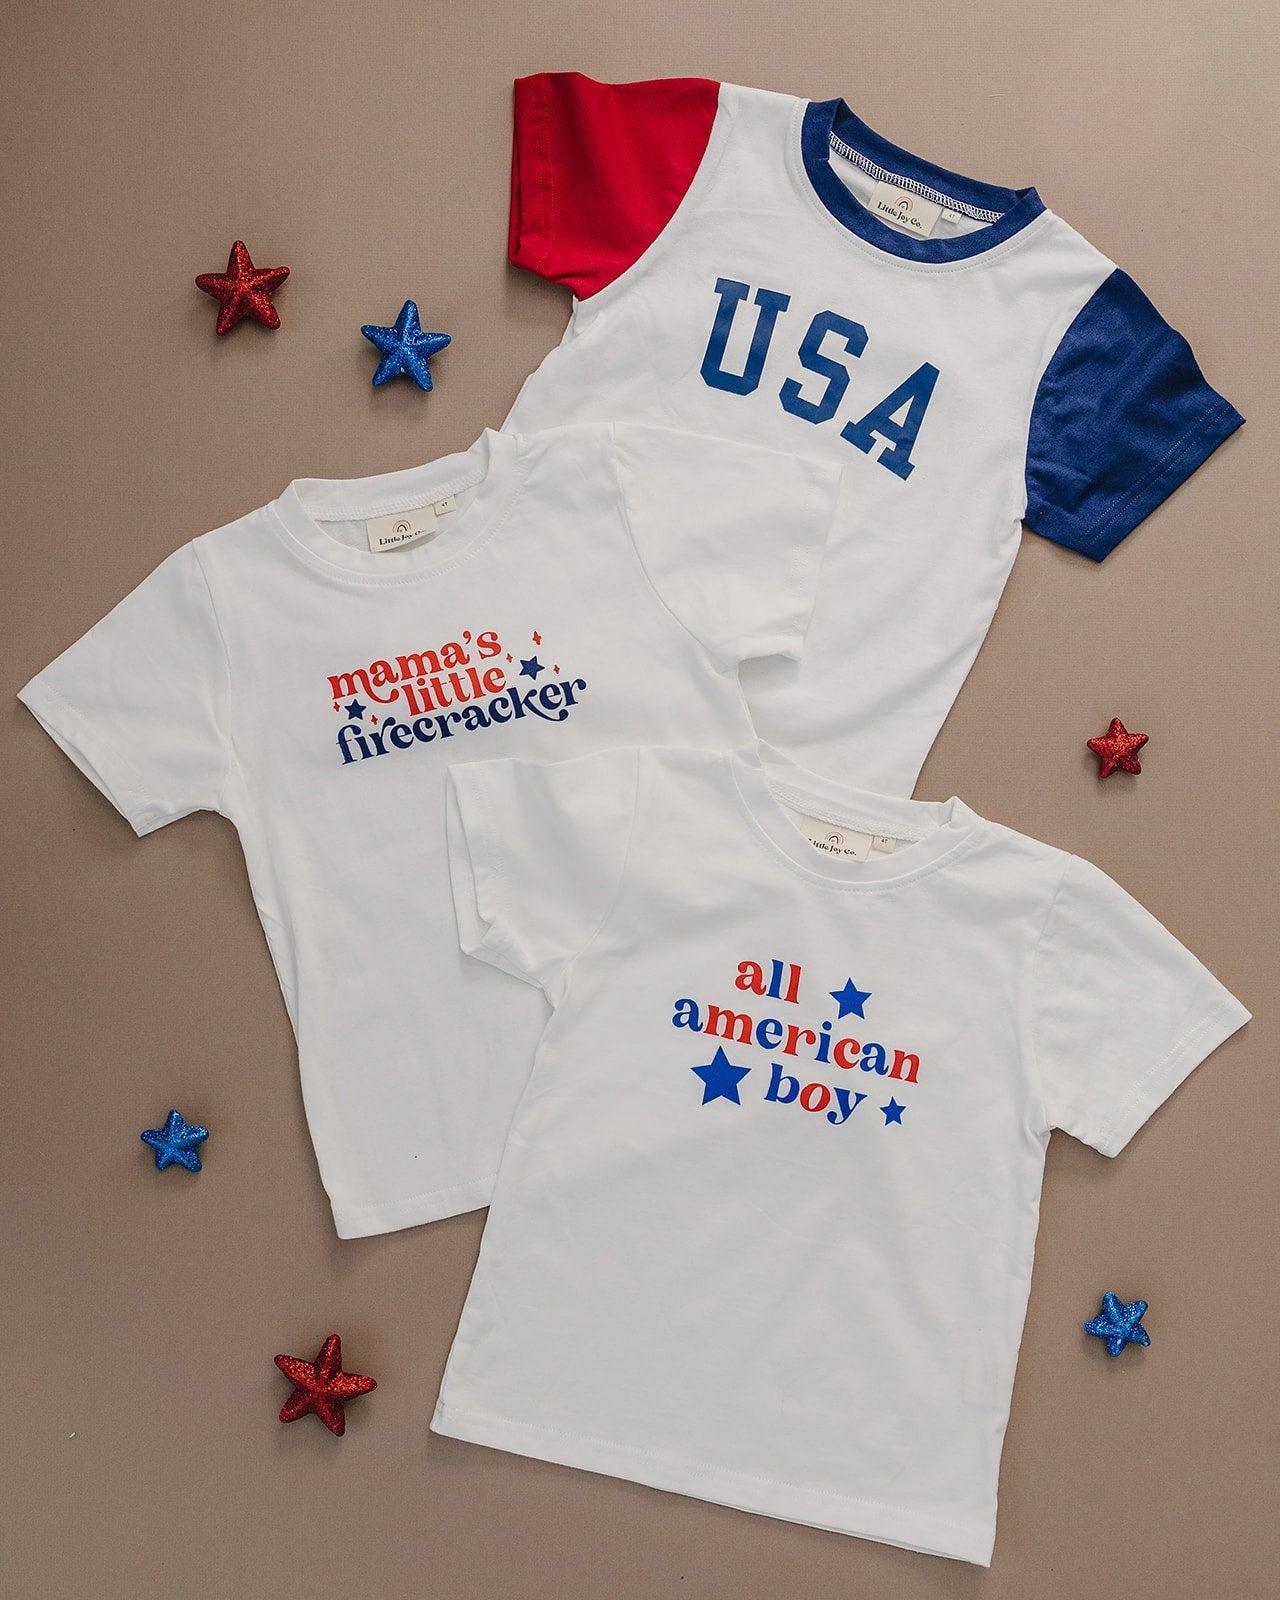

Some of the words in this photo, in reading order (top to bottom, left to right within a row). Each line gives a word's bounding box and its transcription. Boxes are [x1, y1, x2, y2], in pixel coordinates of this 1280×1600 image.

[877, 201, 897, 217] Little
[897, 211, 909, 223] Joy
[910, 217, 922, 229] Co.
[700, 277, 940, 481] USA
[379, 536, 401, 546] Little
[401, 533, 413, 541] Joy
[326, 630, 502, 704] mama's
[401, 666, 507, 717] little
[336, 677, 587, 765] firecracker
[808, 838, 829, 850] ittle
[829, 845, 842, 854] Joy
[843, 848, 857, 856] Co.
[734, 958, 801, 1005] all
[671, 997, 920, 1084] american
[763, 1063, 868, 1126] boy
